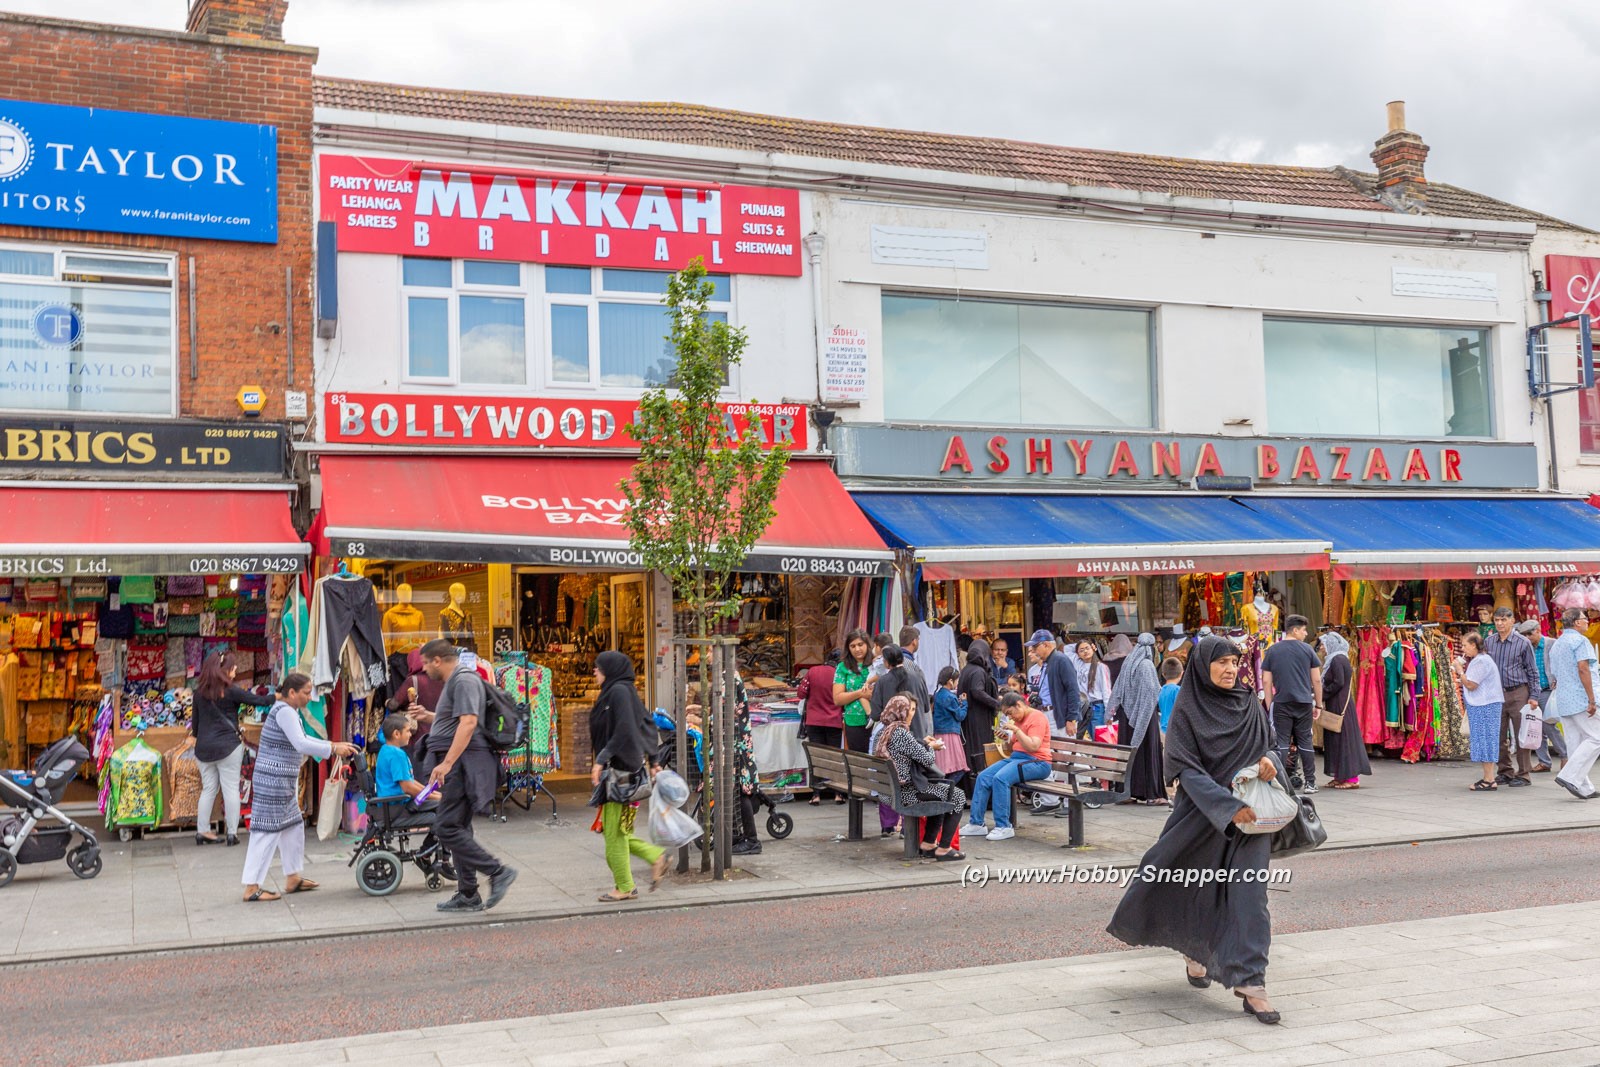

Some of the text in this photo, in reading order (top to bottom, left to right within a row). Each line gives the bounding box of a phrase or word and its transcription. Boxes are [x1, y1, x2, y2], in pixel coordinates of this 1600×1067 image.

[46, 142, 245, 185] TAYLOR
[330, 175, 413, 194] PARTY WEAR
[342, 194, 402, 211] LEHANGA
[415, 170, 722, 234] MAKKAH
[740, 203, 785, 217] PUNJABI
[121, 207, 251, 226] www.faranitaylor.com
[347, 213, 397, 229] SAREES
[742, 222, 785, 236] SUITS &
[415, 221, 722, 264] BRIDAL
[734, 241, 793, 256] SHERWANI
[65, 362, 155, 378] TAYLOR
[10, 381, 104, 395] SOLICITORS
[244, 395, 259, 403] ADT
[331, 394, 346, 404] 83
[727, 405, 746, 415] 020
[775, 406, 800, 416] 0407
[339, 402, 615, 441] BOLLYWOOD
[205, 428, 278, 439] 020 8867 9429
[0, 429, 156, 465] BRICS
[939, 434, 1463, 482] ASHYANA BAZAAR
[347, 542, 365, 556] 83
[0, 558, 112, 574] BRICS Ltd.
[190, 557, 298, 573] 020 8867 9429
[781, 557, 881, 575] 020 8843 0407
[1077, 559, 1195, 573] ASHYANA BAZAAR
[1475, 563, 1578, 575] ASHYANA BAZAAR
[494, 638, 512, 654] 83
